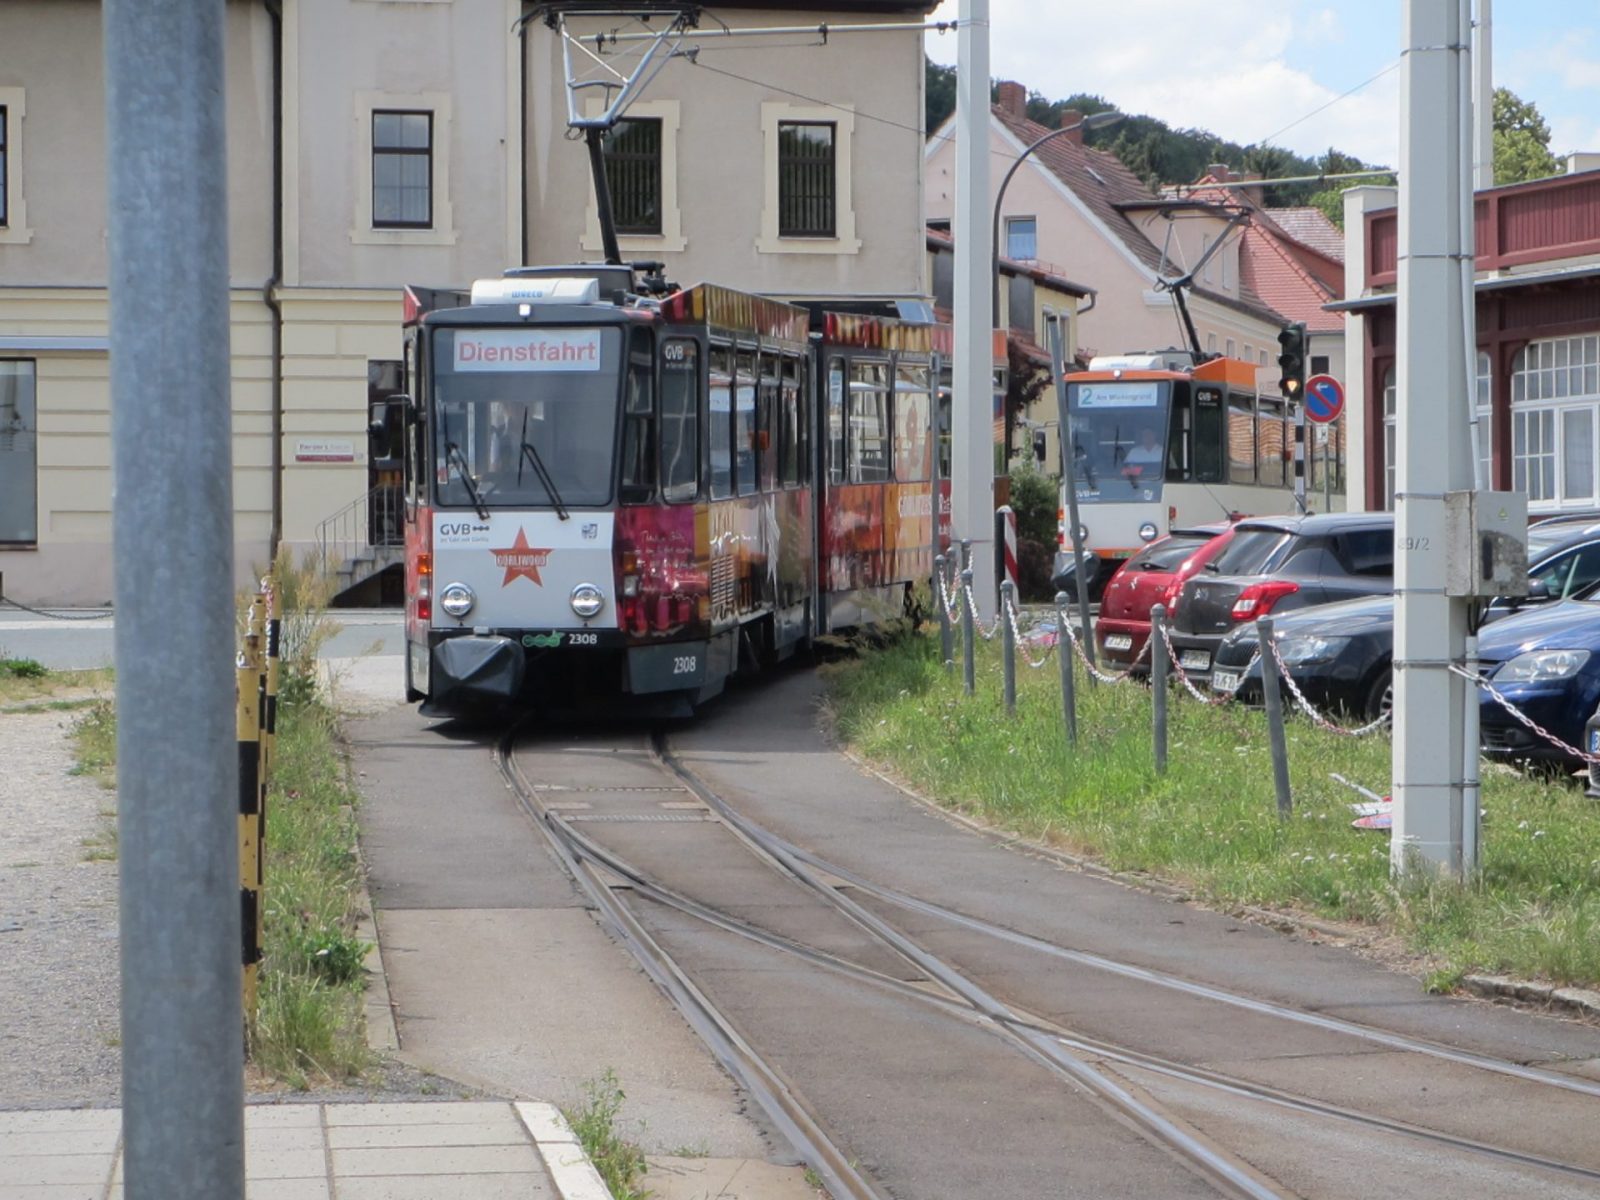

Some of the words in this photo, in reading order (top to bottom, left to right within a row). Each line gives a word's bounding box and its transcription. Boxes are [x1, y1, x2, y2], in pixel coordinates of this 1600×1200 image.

[459, 342, 596, 362] Dienstfahrt
[665, 344, 684, 360] GVB
[1081, 387, 1093, 405] 2
[440, 523, 471, 536] GVB
[568, 633, 598, 645] 2308
[673, 656, 697, 674] 2308
